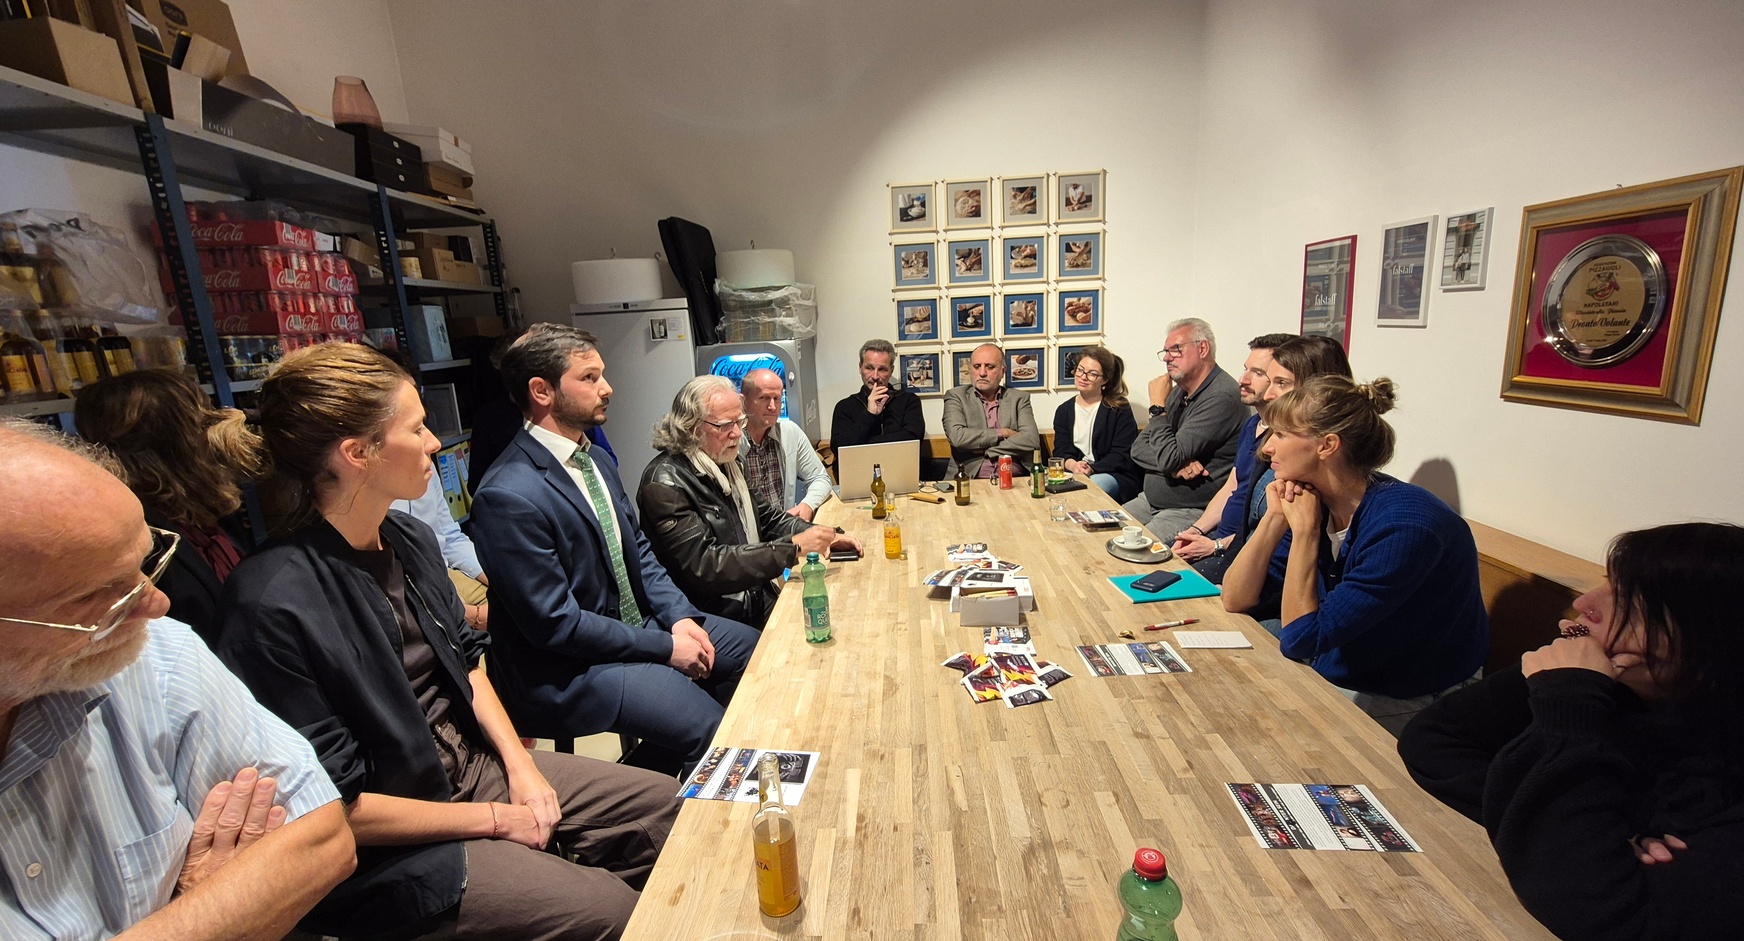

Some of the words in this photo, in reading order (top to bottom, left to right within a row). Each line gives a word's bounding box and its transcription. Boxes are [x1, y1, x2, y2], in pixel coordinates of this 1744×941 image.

[1393, 263, 1415, 275] falstaff
[1314, 293, 1337, 306] falstaff
[1571, 319, 1598, 329] Pronto
[1598, 317, 1630, 327] Volante
